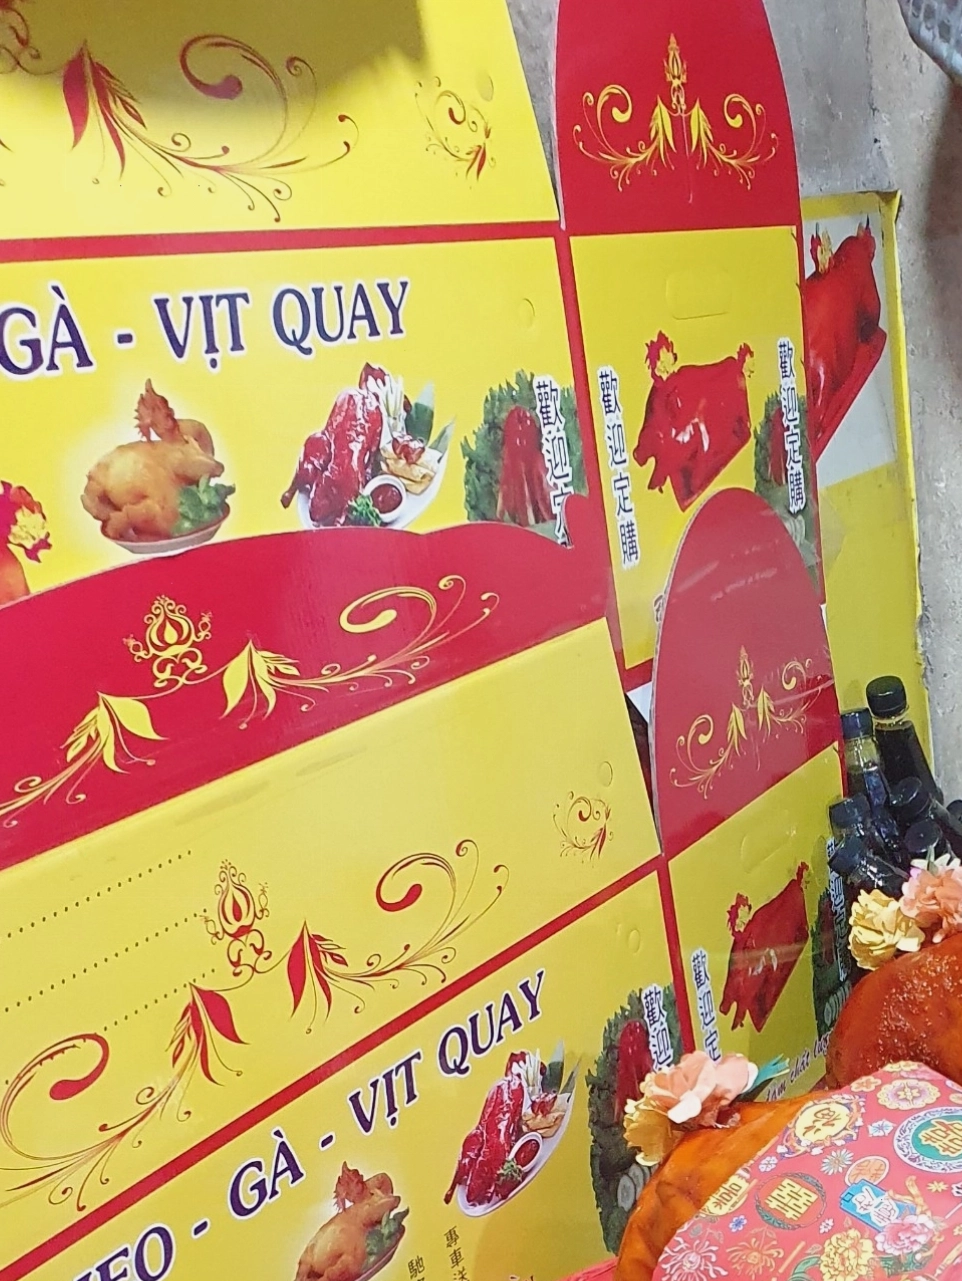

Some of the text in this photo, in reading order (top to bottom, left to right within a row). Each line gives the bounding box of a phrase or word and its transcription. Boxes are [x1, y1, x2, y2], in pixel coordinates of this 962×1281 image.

[0, 285, 93, 375] GÀ
[154, 293, 249, 369] VỊT
[273, 281, 408, 355] QUAY
[599, 369, 639, 564] 歡迎定購
[229, 1130, 303, 1217] GÀ
[347, 1053, 422, 1134] VỊT
[438, 971, 545, 1077] QUAY
